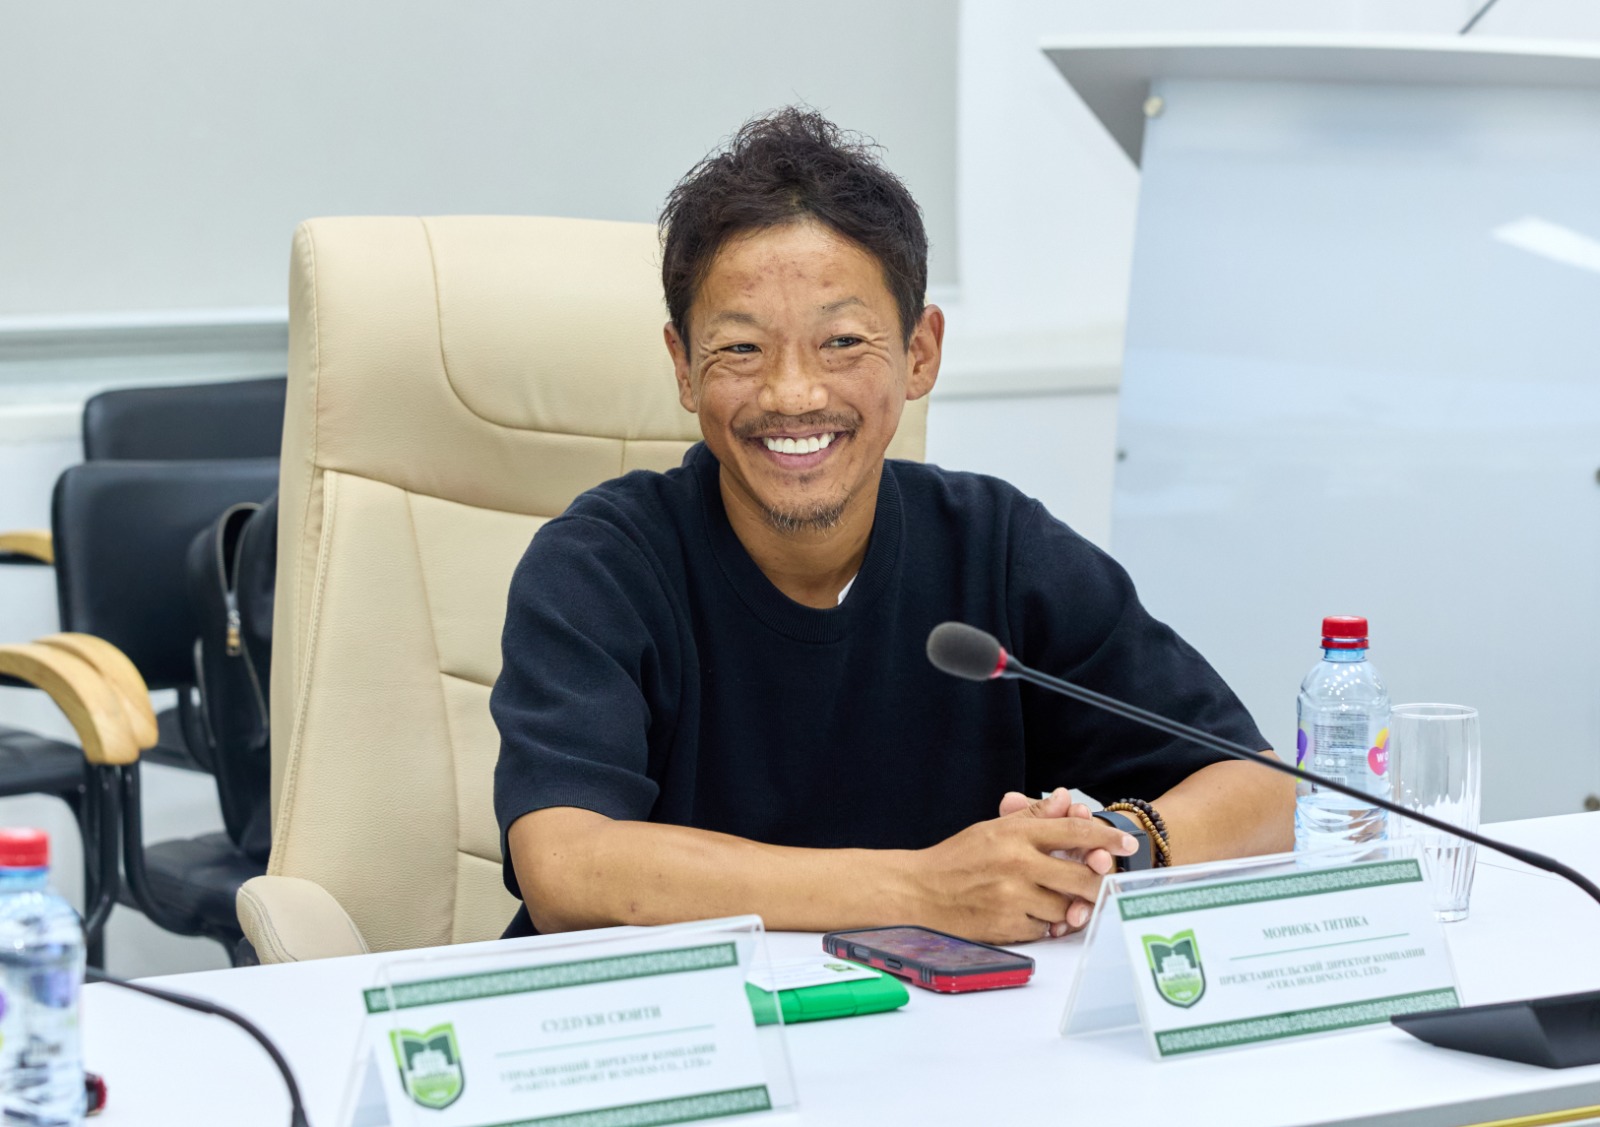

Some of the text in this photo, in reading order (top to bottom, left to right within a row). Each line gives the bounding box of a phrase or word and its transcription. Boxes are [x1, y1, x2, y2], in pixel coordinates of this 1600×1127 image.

[1262, 915, 1369, 940] МОРИОКА ТИТИКА
[1325, 955, 1371, 973] ДИРЕКТОР
[1372, 947, 1426, 963] КОМПАНИИ
